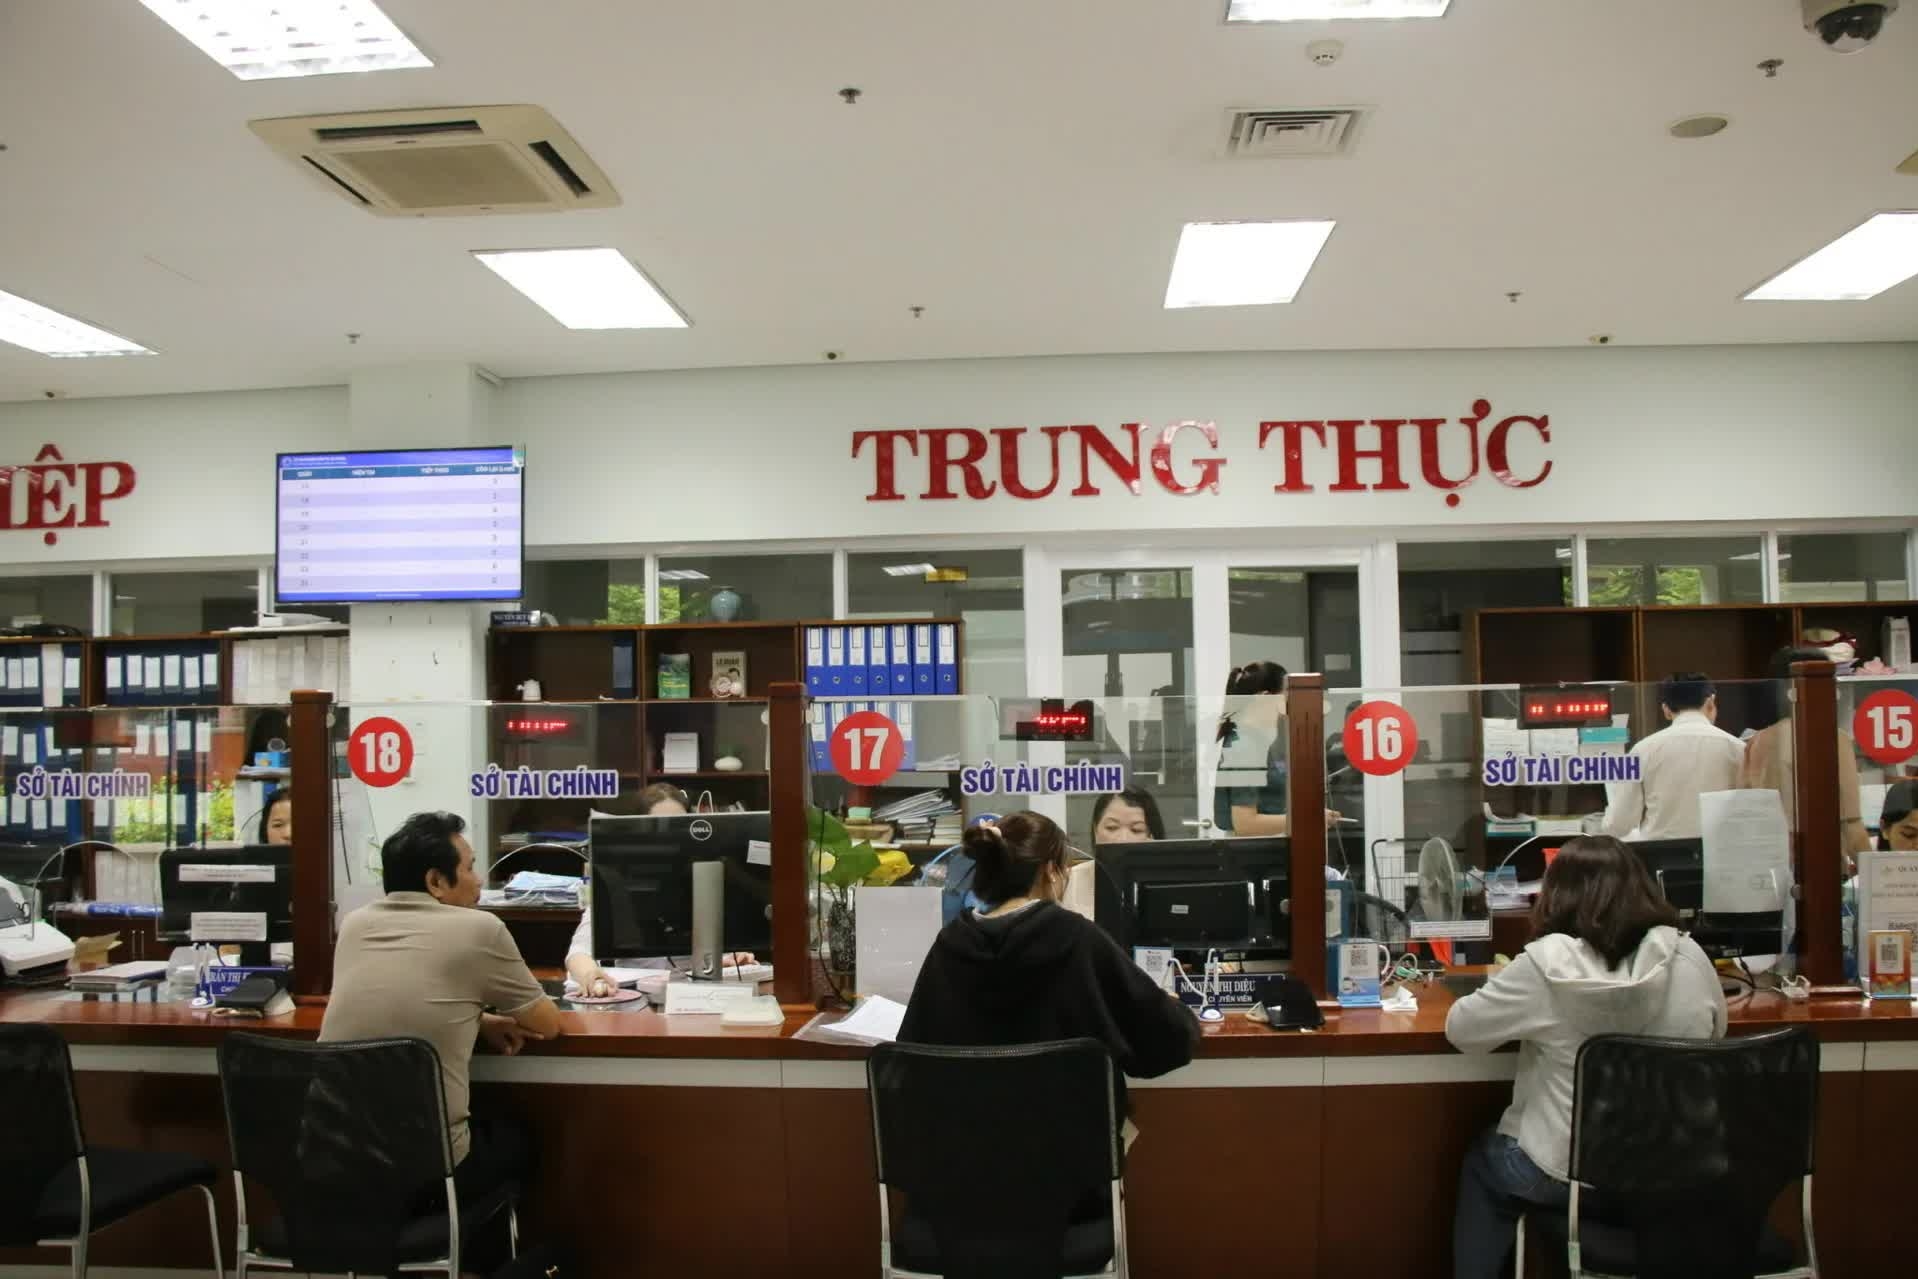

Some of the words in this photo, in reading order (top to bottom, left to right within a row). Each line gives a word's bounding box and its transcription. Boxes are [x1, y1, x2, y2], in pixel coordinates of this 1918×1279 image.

[851, 420, 1228, 501] TRUNG
[1258, 398, 1553, 507] THỰC
[843, 727, 889, 770] 17
[1355, 716, 1403, 761] 16
[1866, 705, 1913, 749] 15
[359, 731, 401, 774] 18
[1485, 750, 1517, 784] SỞ
[1523, 753, 1560, 783] TÀI
[1567, 751, 1640, 782] CHÍNH
[18, 767, 45, 797] SỞ
[51, 769, 81, 797] TÀI
[87, 769, 149, 797] CHÍNH
[471, 765, 500, 797] SỞ
[506, 768, 540, 796] TÀI
[548, 767, 616, 796] CHÍNH
[963, 760, 995, 793] SỞ
[1001, 763, 1039, 793] TÀI
[1047, 762, 1121, 792] CHÍNH
